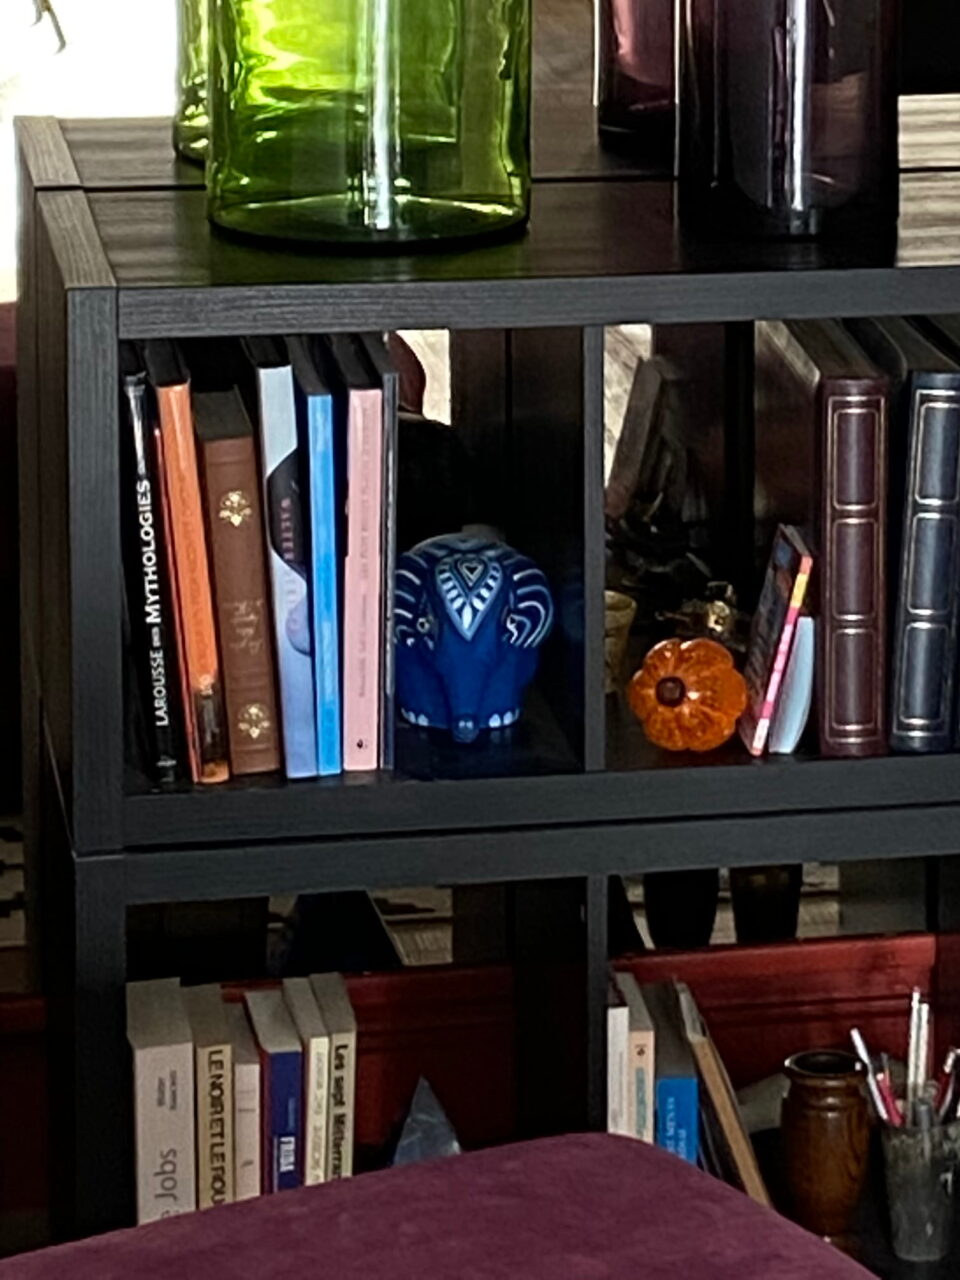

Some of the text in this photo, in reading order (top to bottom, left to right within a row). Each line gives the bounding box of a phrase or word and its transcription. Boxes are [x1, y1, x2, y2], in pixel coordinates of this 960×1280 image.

[138, 480, 162, 624] MYTHOLOGIES
[154, 650, 169, 727] LAROUSSE
[208, 1049, 225, 1072] LE
[334, 1043, 349, 1070] Les
[208, 1074, 225, 1115] NOIR
[332, 1076, 346, 1107] sept
[209, 1117, 225, 1140] ET
[210, 1142, 225, 1165] LE
[153, 1148, 178, 1202] Jobs
